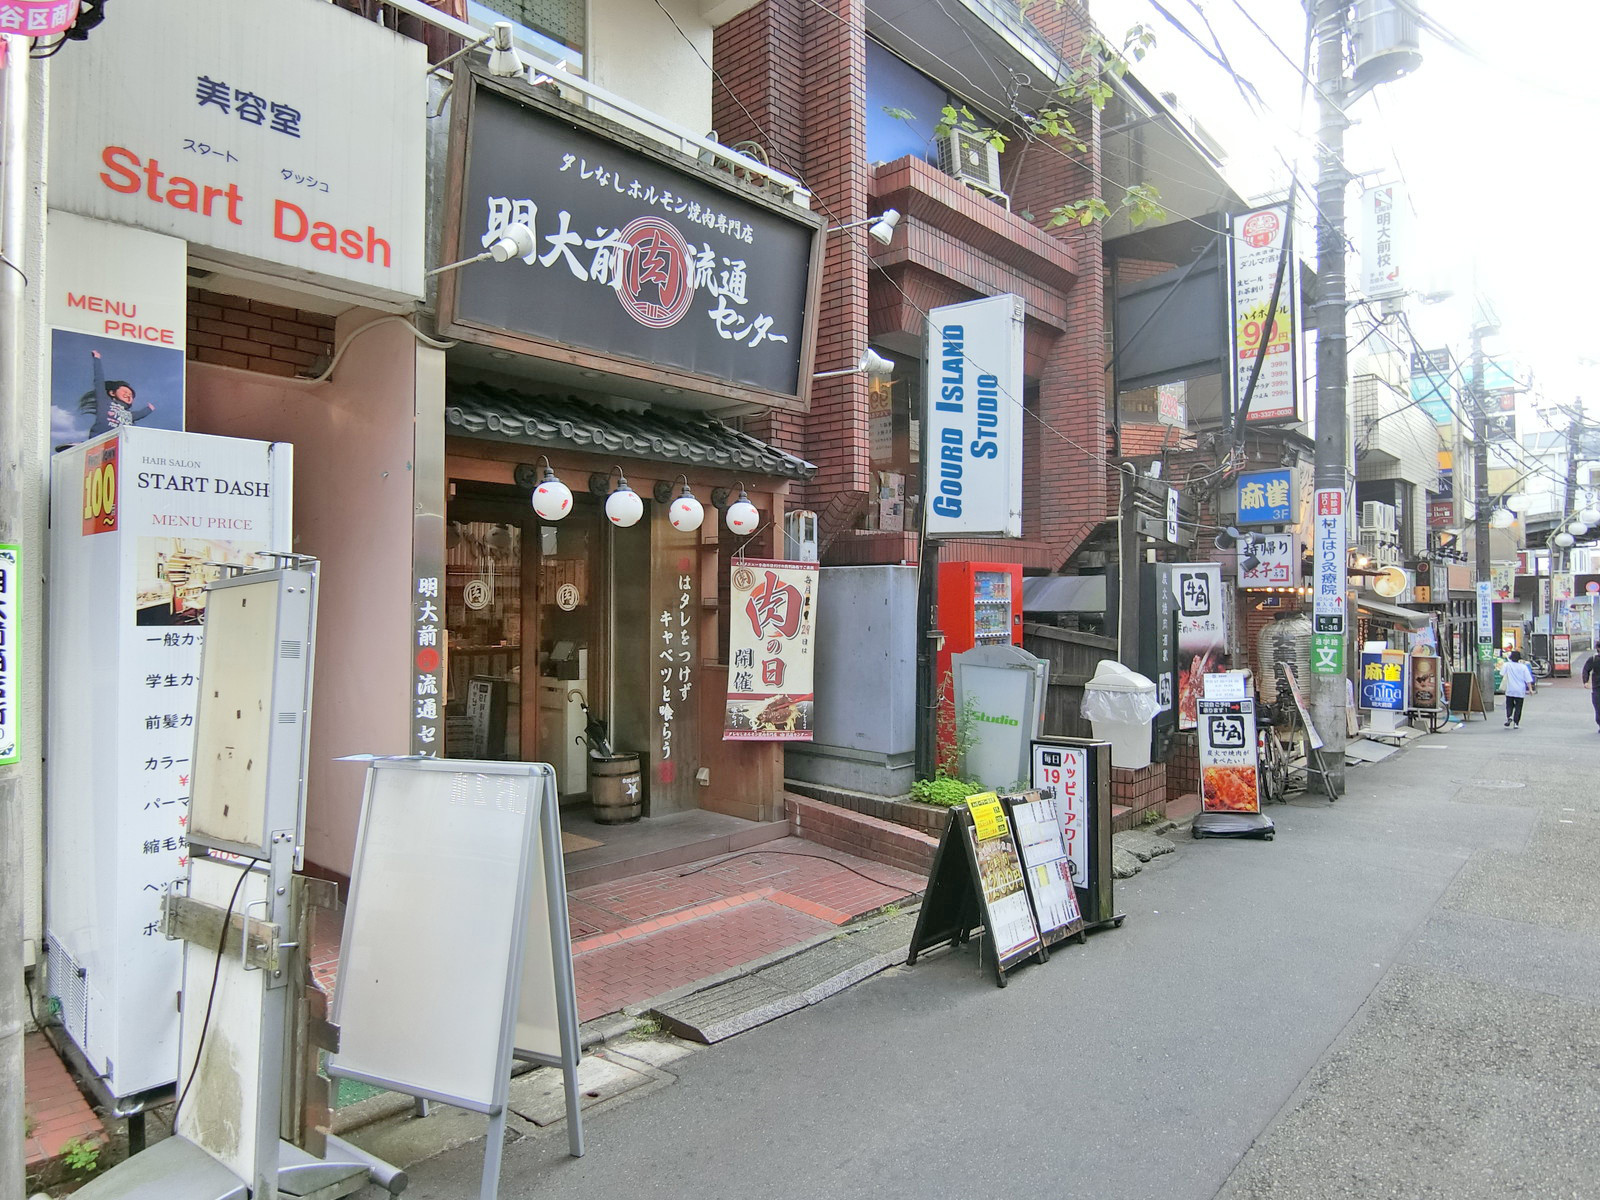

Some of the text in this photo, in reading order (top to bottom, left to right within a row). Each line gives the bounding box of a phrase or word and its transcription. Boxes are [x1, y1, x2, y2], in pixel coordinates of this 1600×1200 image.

[0, 4, 73, 30] 谷区商
[196, 75, 302, 139] 美容室
[183, 139, 238, 163] スタート
[99, 144, 392, 268] Start Dash
[560, 153, 754, 245] タレなしホルモン焼肉専門店
[1376, 212, 1391, 267] 明大前校
[67, 291, 137, 319] MENU
[105, 319, 175, 345] PRICE
[708, 295, 788, 348] センター
[936, 325, 964, 413] ISLAND
[970, 374, 998, 460] STUDIO
[142, 456, 201, 469] HAIR SALON
[932, 428, 963, 518] GOURD
[138, 472, 270, 497] START DASH
[1241, 479, 1289, 510] 麻雀
[152, 514, 253, 531] MENU PRICE
[1273, 509, 1289, 520] 3F
[1321, 518, 1337, 595] 村上はり灸療院
[417, 577, 439, 647] 明大前
[678, 575, 693, 702] はタレをつけず
[145, 673, 200, 689] 学生カ
[659, 611, 674, 760] キャベツと喰らう
[734, 648, 754, 692] 開催
[1364, 662, 1402, 681] 麻雀
[1213, 721, 1241, 741] 牛角
[144, 756, 190, 771] カラー
[1043, 753, 1060, 763] 毎日
[1043, 769, 1061, 784] 19
[1063, 752, 1077, 857] ハッピーアワー
